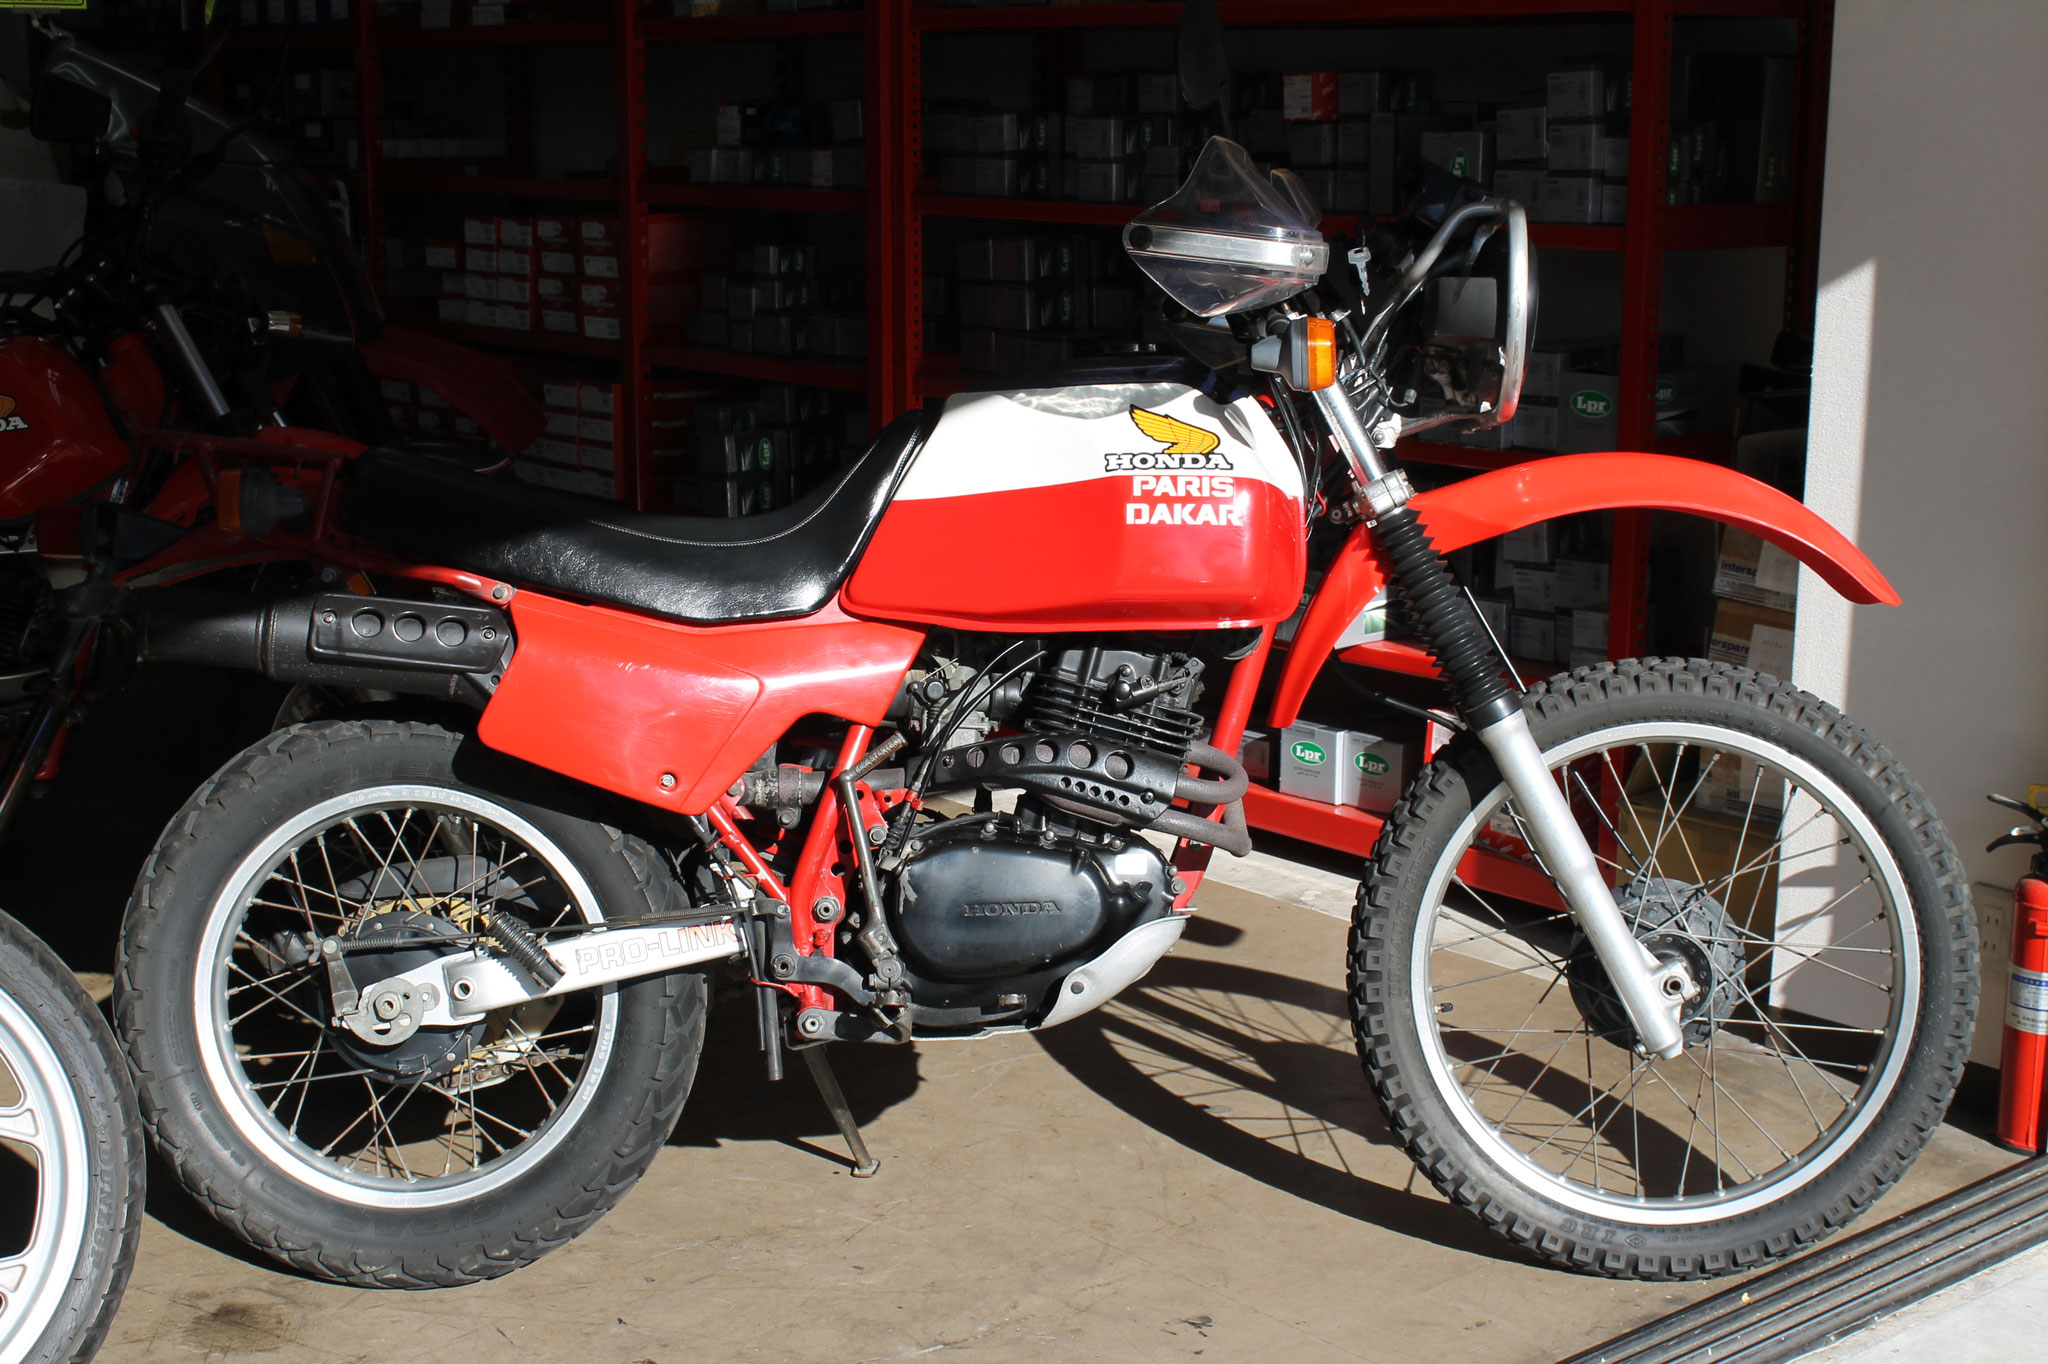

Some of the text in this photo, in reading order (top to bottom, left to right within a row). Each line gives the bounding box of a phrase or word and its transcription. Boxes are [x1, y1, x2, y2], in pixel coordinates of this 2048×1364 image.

[1576, 395, 1608, 414] Lpr
[1104, 452, 1234, 472] HONDA
[1132, 475, 1236, 498] PARIS
[1126, 503, 1244, 526] DAKAR
[1295, 744, 1323, 763] Lpr
[1358, 755, 1386, 775] Lpr
[963, 900, 1062, 917] HONDA
[576, 919, 742, 974] PRO-LINK
[92, 1148, 115, 1269] DUNLOP
[1560, 1216, 1617, 1245] IRC
